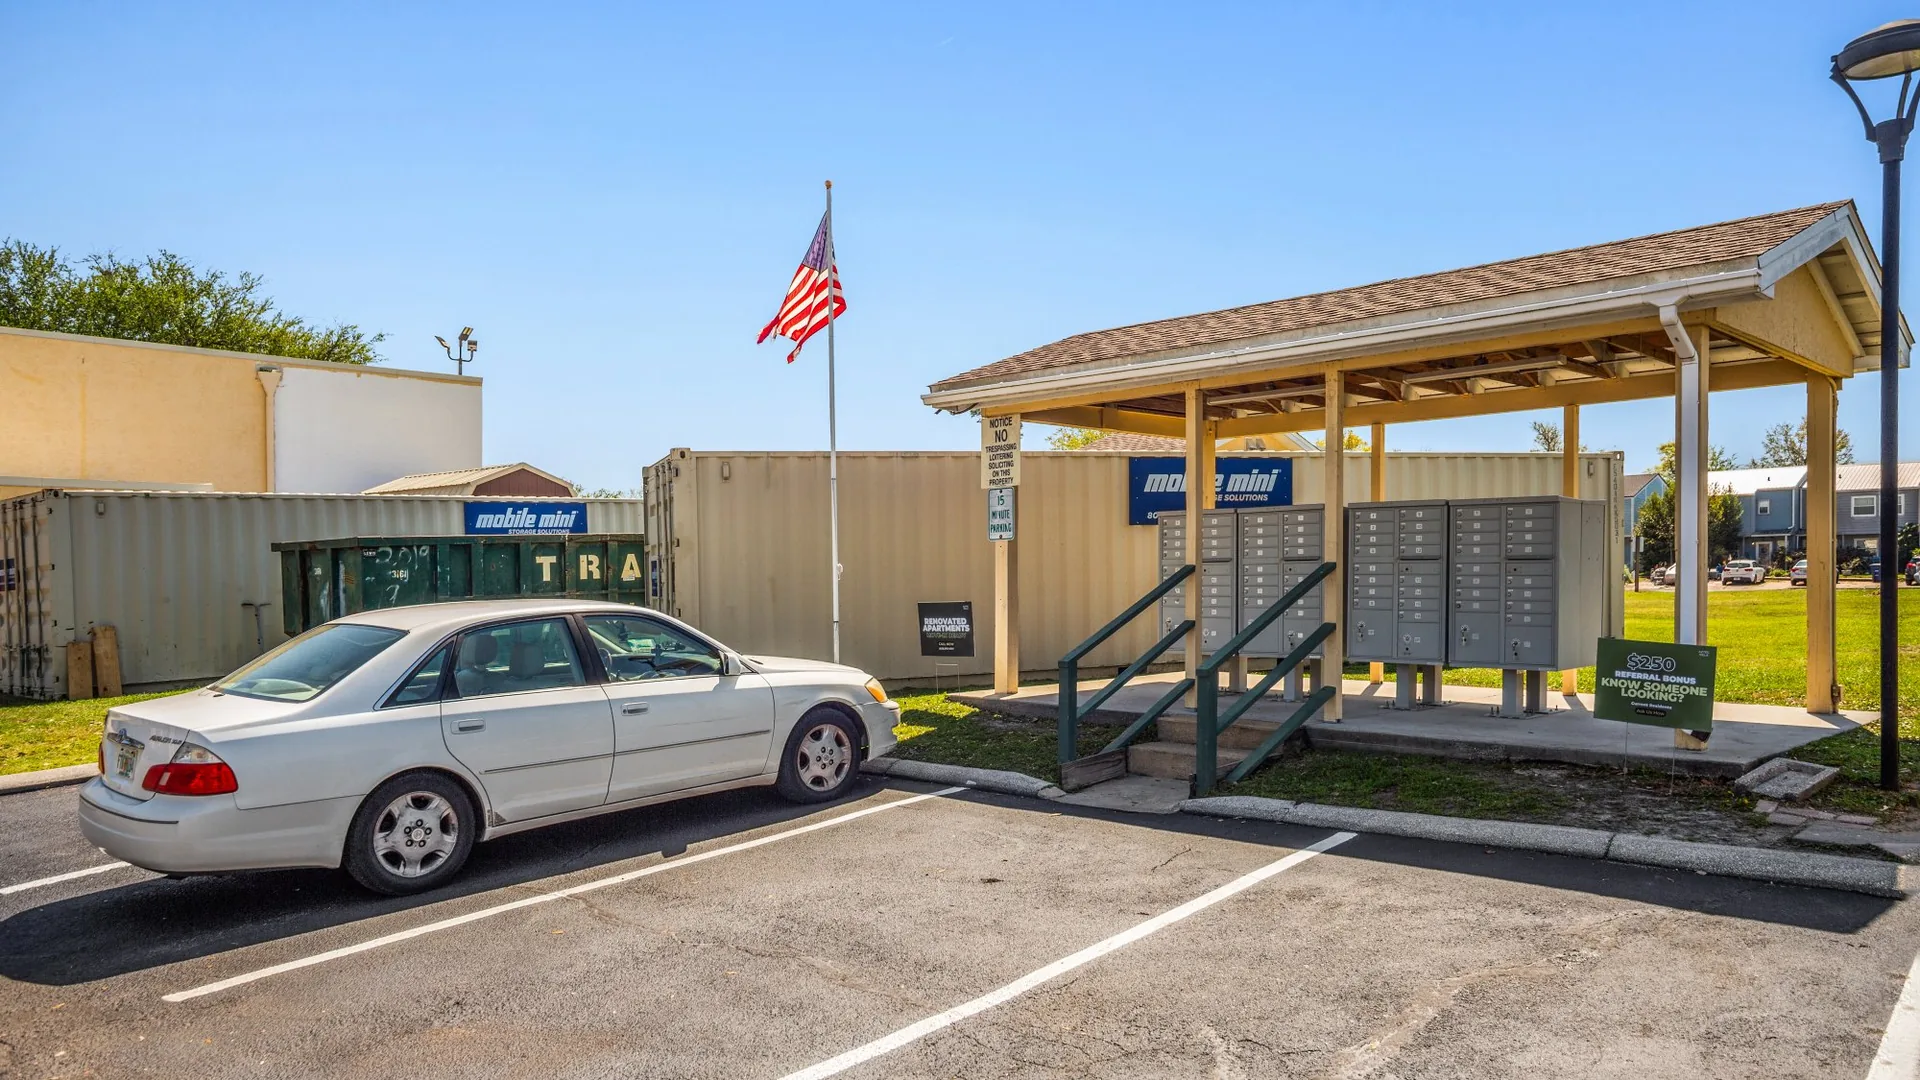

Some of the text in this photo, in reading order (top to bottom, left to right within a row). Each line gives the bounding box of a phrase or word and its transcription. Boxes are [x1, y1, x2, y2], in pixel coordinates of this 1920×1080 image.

[989, 417, 1013, 428] NOTICE
[994, 428, 1008, 443] NO
[985, 442, 1017, 453] TRESPASSING
[989, 451, 1013, 461] LOITERING
[988, 459, 1014, 470] SOLICITING
[992, 468, 1010, 478] ON THIS
[988, 477, 1013, 487] PROPERTY
[1226, 468, 1279, 492] mini
[997, 494, 1005, 506] 15
[1223, 493, 1268, 502] SOLUTIONS
[475, 507, 577, 528] mobile mini
[992, 509, 1010, 520] MINUTE
[990, 522, 1012, 533] PARKING
[924, 617, 967, 625] RENOVATED
[923, 624, 970, 632] APARTMENTS
[1626, 652, 1676, 672] $250
[1615, 670, 1697, 685] REFERRAL BONUS
[1600, 677, 1708, 696] KNOW SOMEONE
[1620, 687, 1685, 703] LOOKING?
